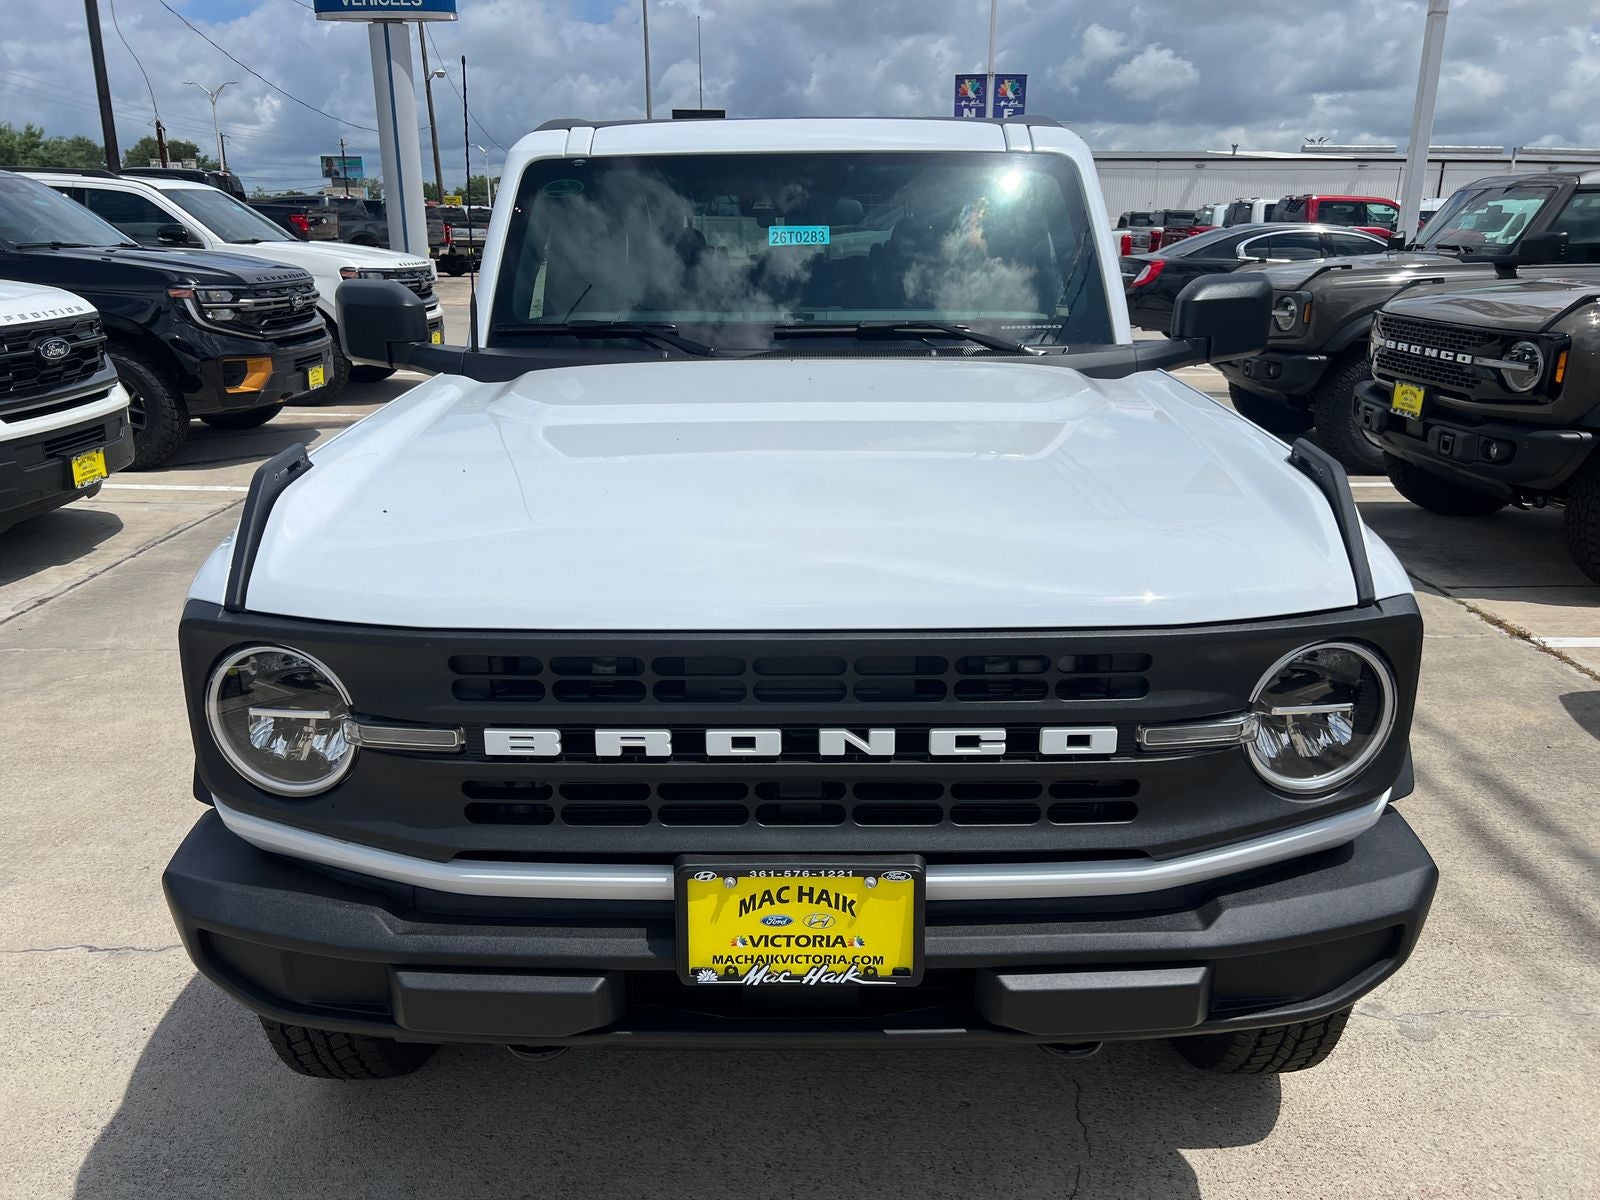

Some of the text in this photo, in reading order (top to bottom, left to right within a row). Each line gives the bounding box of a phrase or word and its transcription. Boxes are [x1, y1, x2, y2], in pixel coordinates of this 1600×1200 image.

[771, 230, 825, 244] 26T0283
[1385, 339, 1473, 364] BRONCO
[484, 726, 1118, 757] BRONCO
[749, 870, 854, 878] 361-576-1221
[738, 886, 857, 918] MAC HAIK
[749, 934, 848, 948] VICTORIA
[712, 954, 884, 966] MACHAIKVICTORIA.COM
[742, 964, 865, 986] Mac Haik
